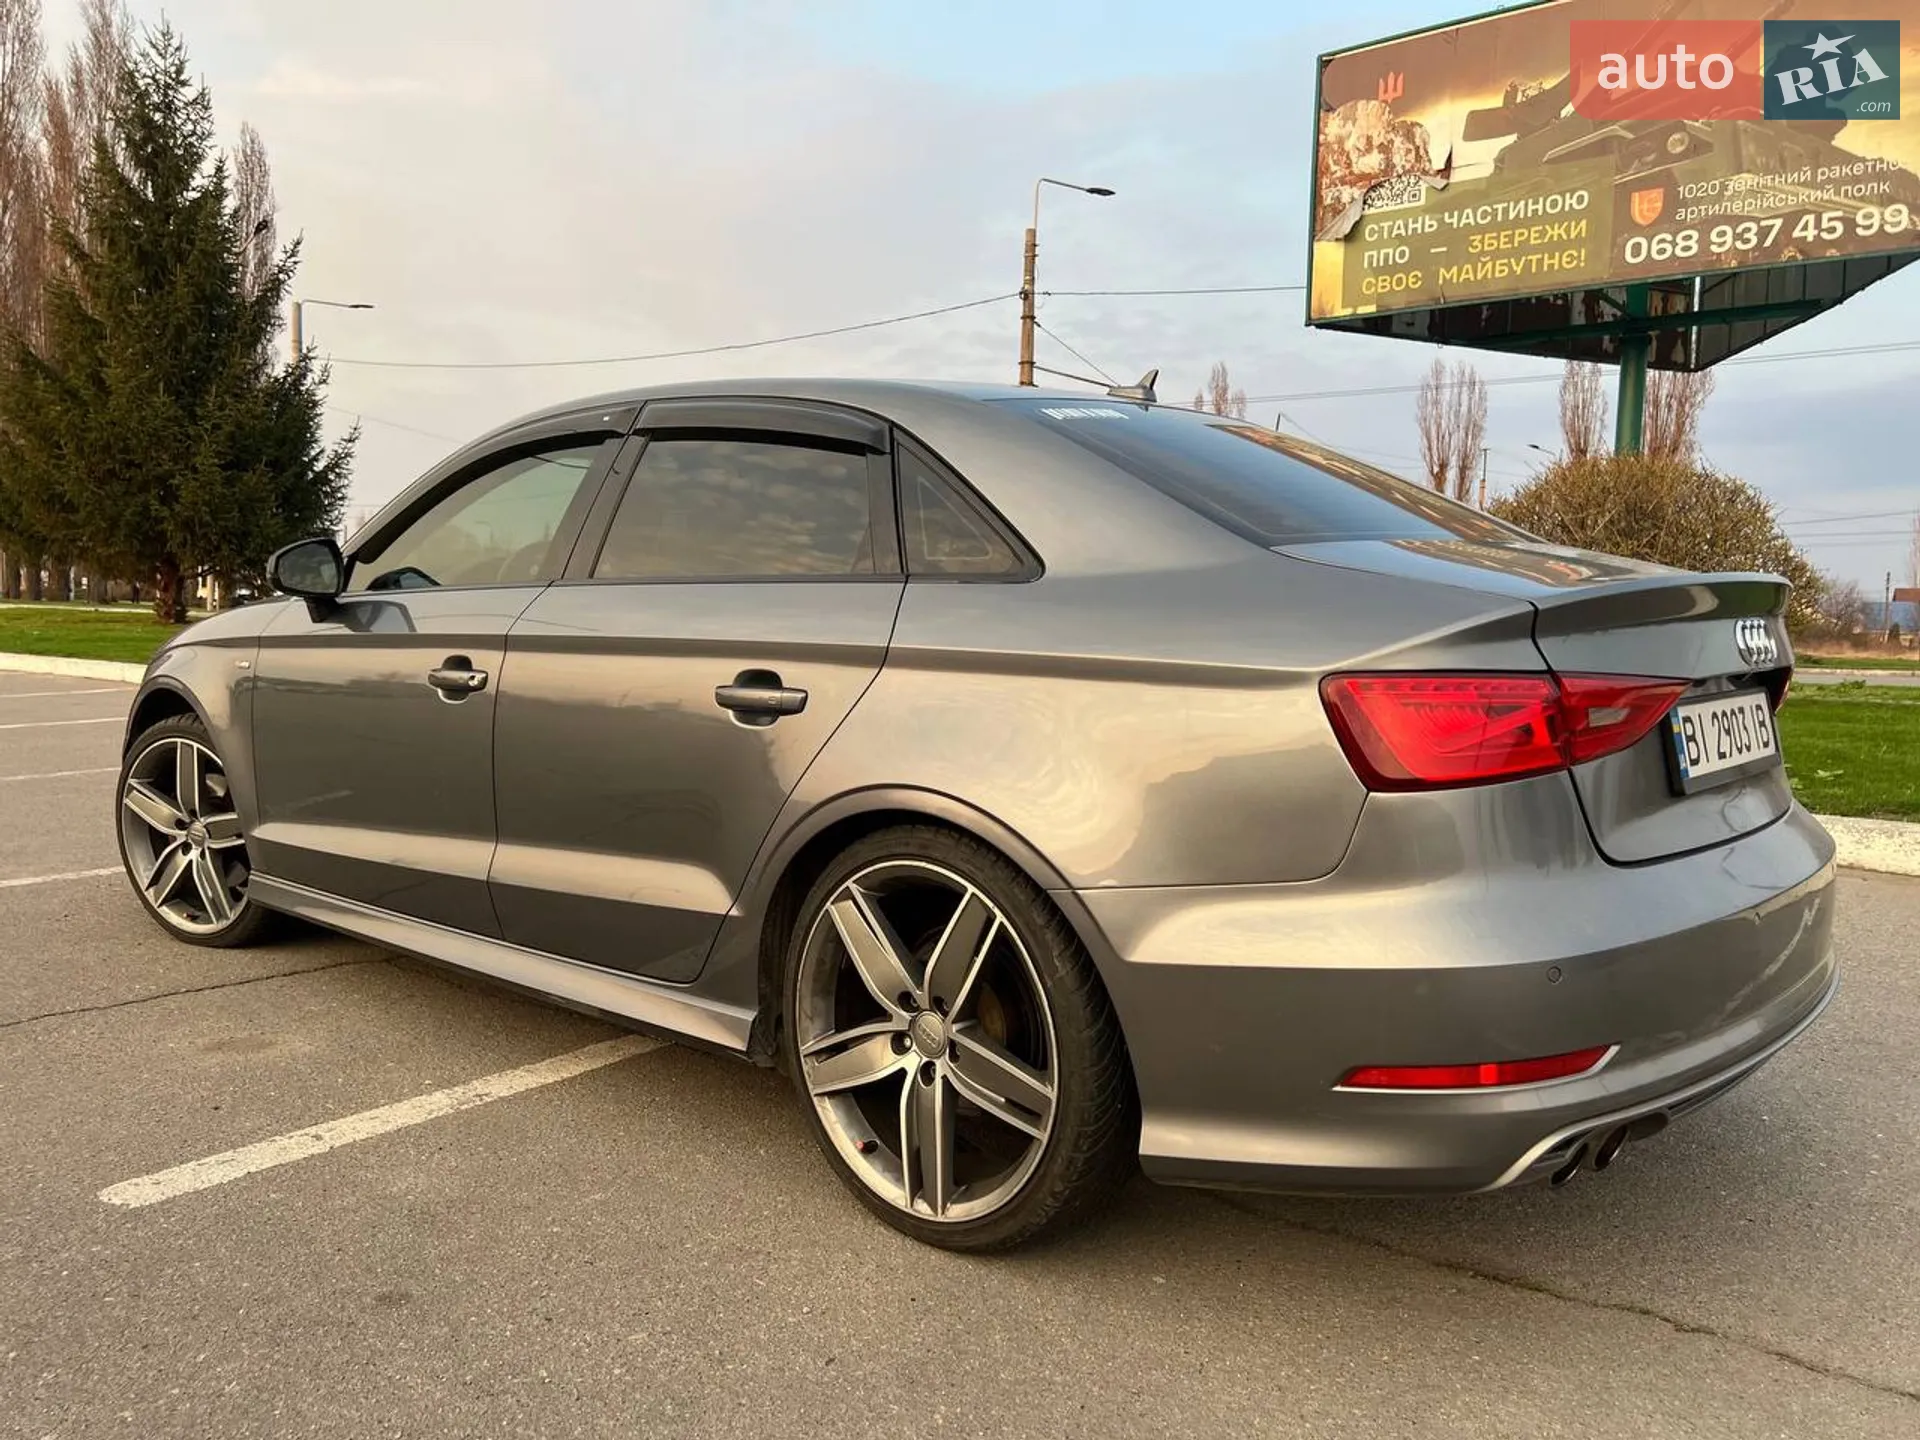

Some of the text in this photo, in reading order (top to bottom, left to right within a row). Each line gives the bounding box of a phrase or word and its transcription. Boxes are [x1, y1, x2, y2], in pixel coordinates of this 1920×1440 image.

[1675, 181, 1891, 222] артилерійський полк
[1677, 180, 1719, 200] 1020
[1724, 168, 1812, 196] зенітний
[1364, 190, 1589, 242] СТАНЬ ЧАСТИНОЮ
[1624, 203, 1909, 264] 068 937 45 99
[1363, 246, 1410, 269] ППО
[1468, 219, 1588, 253] ЗБЕРЕЖИ
[1362, 248, 1586, 295] СВОЄ МАЙБУТНЄ!
[1682, 704, 1770, 766] BI 2903 IB
